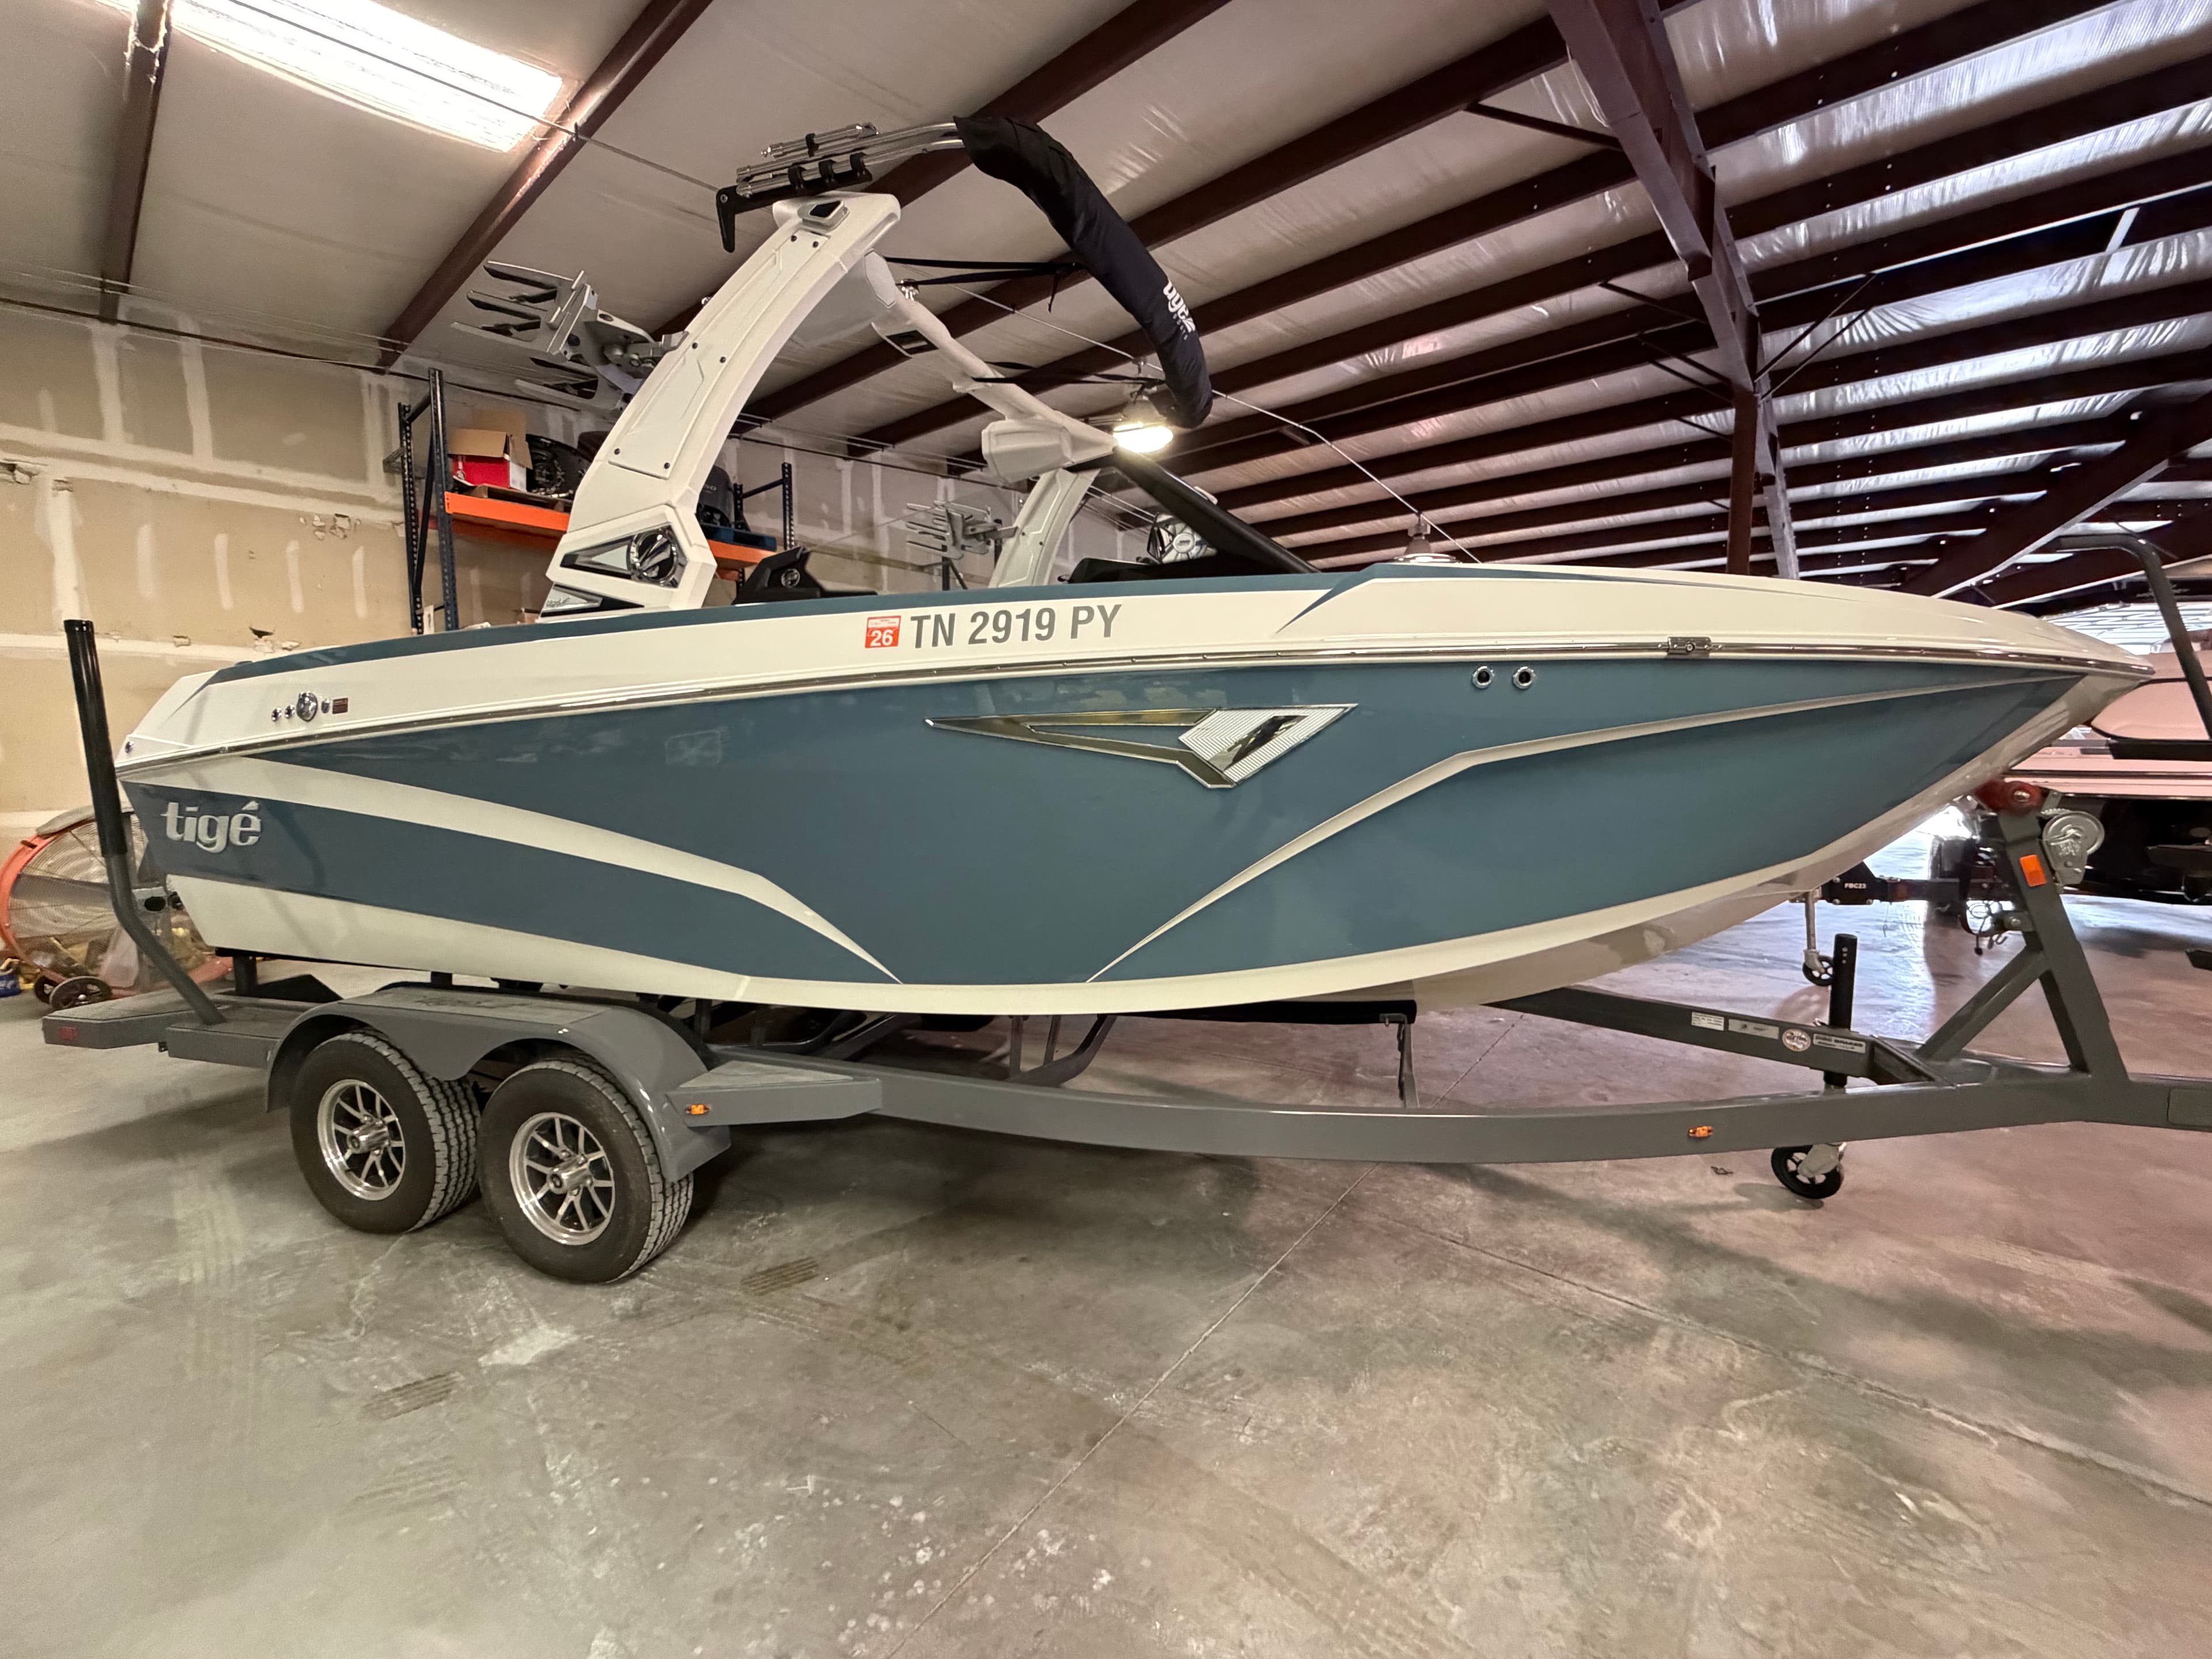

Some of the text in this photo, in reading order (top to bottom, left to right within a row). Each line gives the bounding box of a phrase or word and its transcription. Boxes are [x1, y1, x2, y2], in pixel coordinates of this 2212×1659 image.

[870, 629, 893, 647] 26
[910, 603, 1123, 649] TN 2919 PY
[160, 800, 262, 854] tigé
